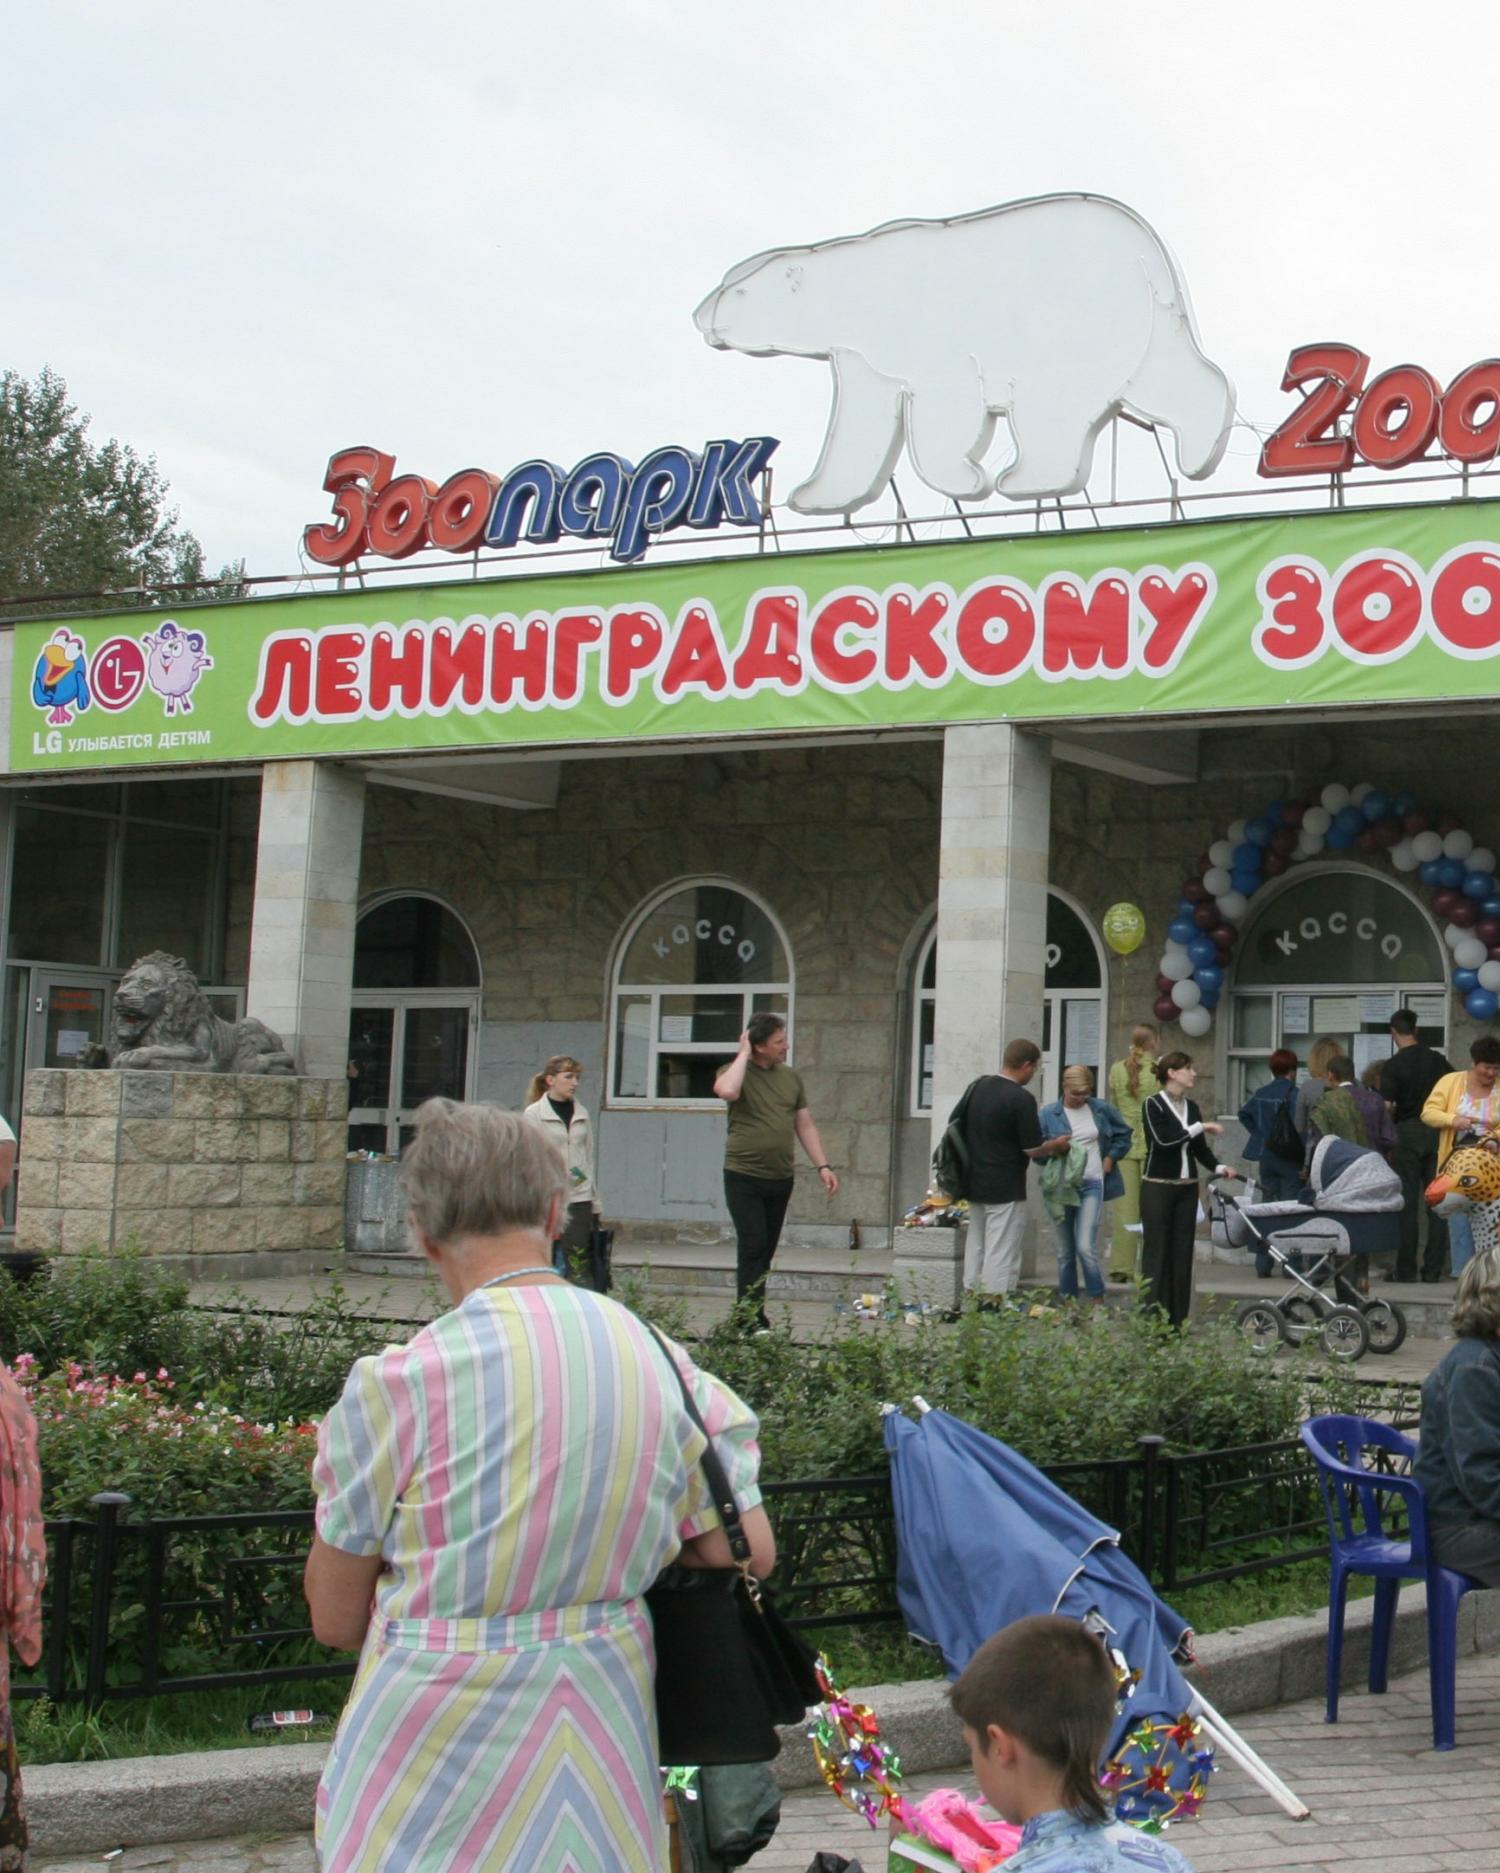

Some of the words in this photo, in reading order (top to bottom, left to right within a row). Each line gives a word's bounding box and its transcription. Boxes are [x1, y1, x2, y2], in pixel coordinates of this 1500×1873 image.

[303, 436, 781, 566] Зоопарк
[252, 575, 1214, 721] ЛЕНИНГРАДСКОМУ
[33, 730, 62, 755] LG
[68, 732, 153, 752] УЛЫБАЕТСЯ
[158, 729, 211, 749] ДЕТЯМ
